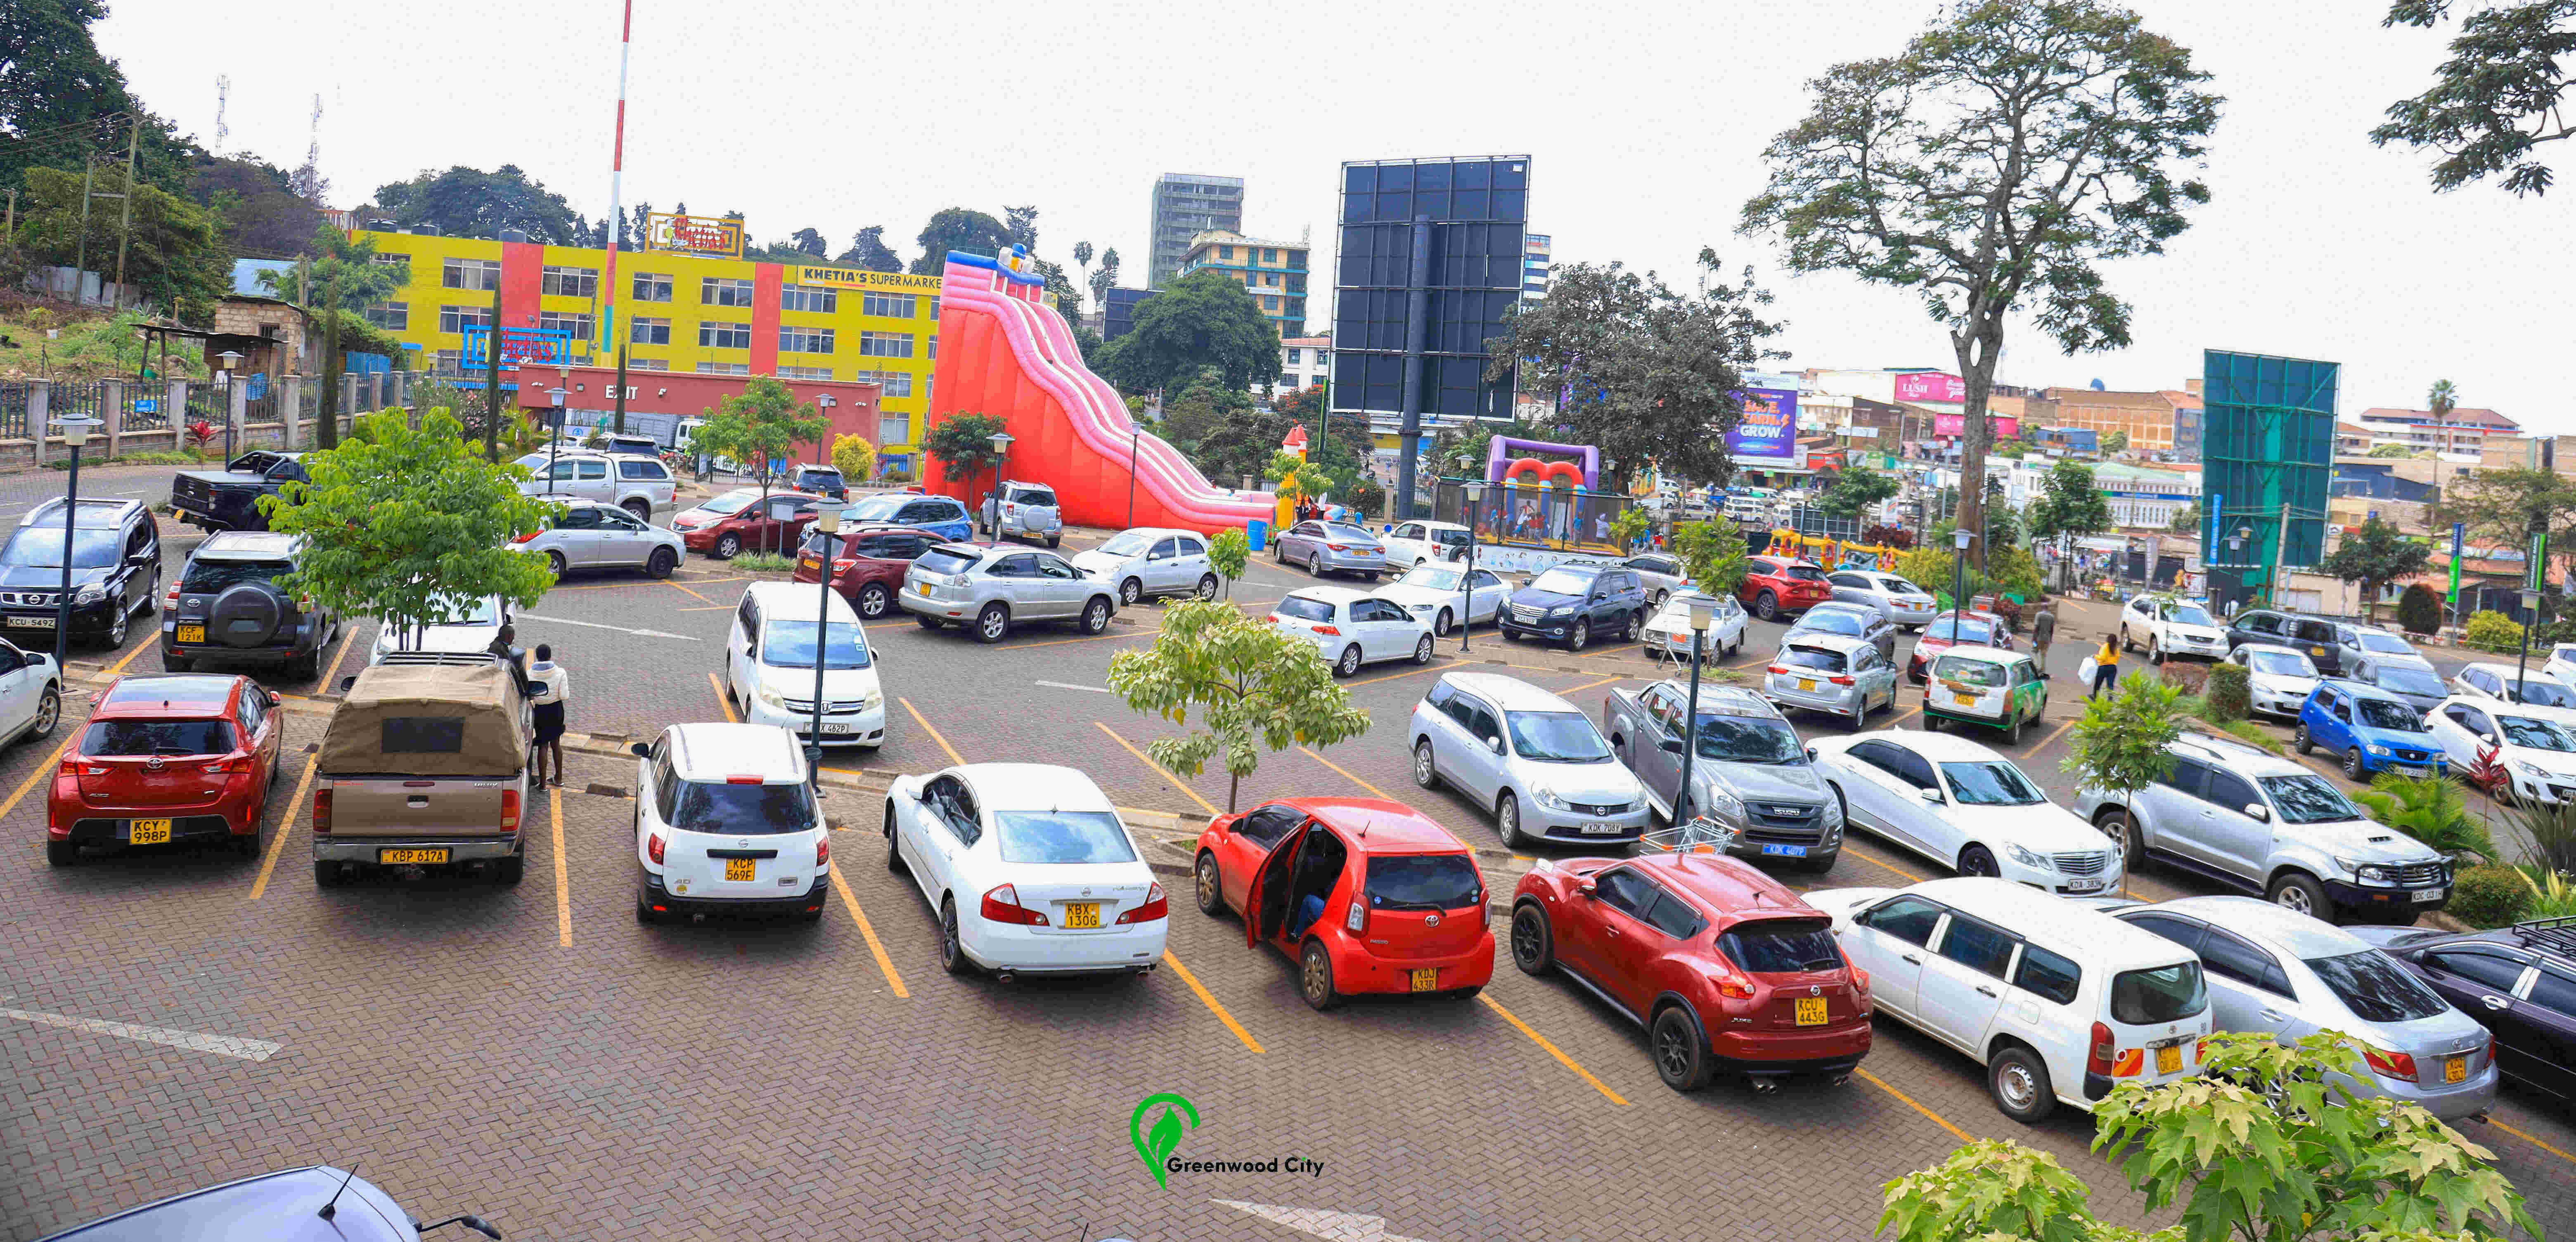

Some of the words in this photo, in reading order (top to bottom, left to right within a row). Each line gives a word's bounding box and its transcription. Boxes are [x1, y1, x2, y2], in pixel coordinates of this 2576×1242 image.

[804, 268, 867, 283] KHETIA'S
[870, 274, 942, 289] SUPERMARKE
[1740, 425, 1785, 439] GROW.
[134, 821, 159, 831] KCY
[135, 830, 166, 842] 998P
[392, 851, 412, 861] KBP
[417, 850, 443, 861] 617A
[733, 859, 753, 868] KCP
[727, 870, 752, 880] 569F
[1068, 904, 1089, 915] KBX
[1069, 915, 1097, 925] 130G
[1798, 1000, 1817, 1010] KCU
[1799, 1011, 1824, 1022] 443G
